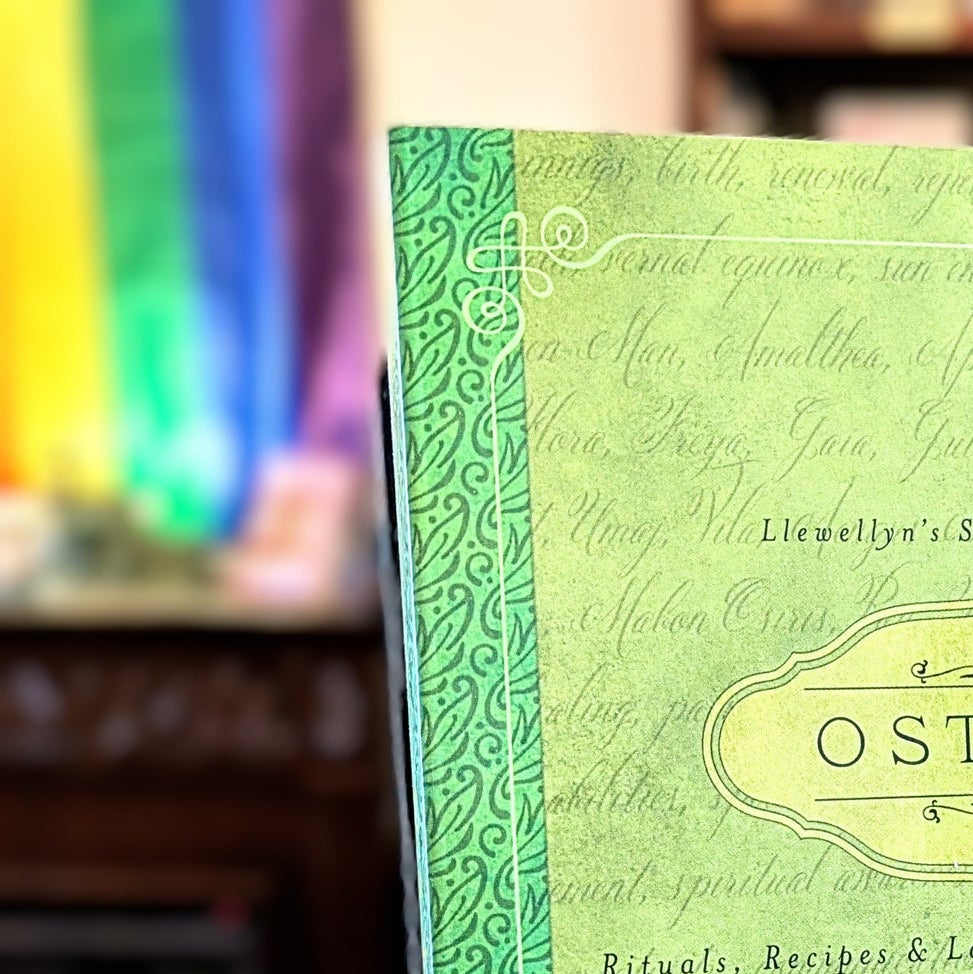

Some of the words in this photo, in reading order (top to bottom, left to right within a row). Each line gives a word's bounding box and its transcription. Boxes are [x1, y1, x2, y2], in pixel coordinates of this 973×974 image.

[877, 256, 933, 283] sun
[713, 297, 891, 381] Amalthea,
[907, 936, 927, 964] &
